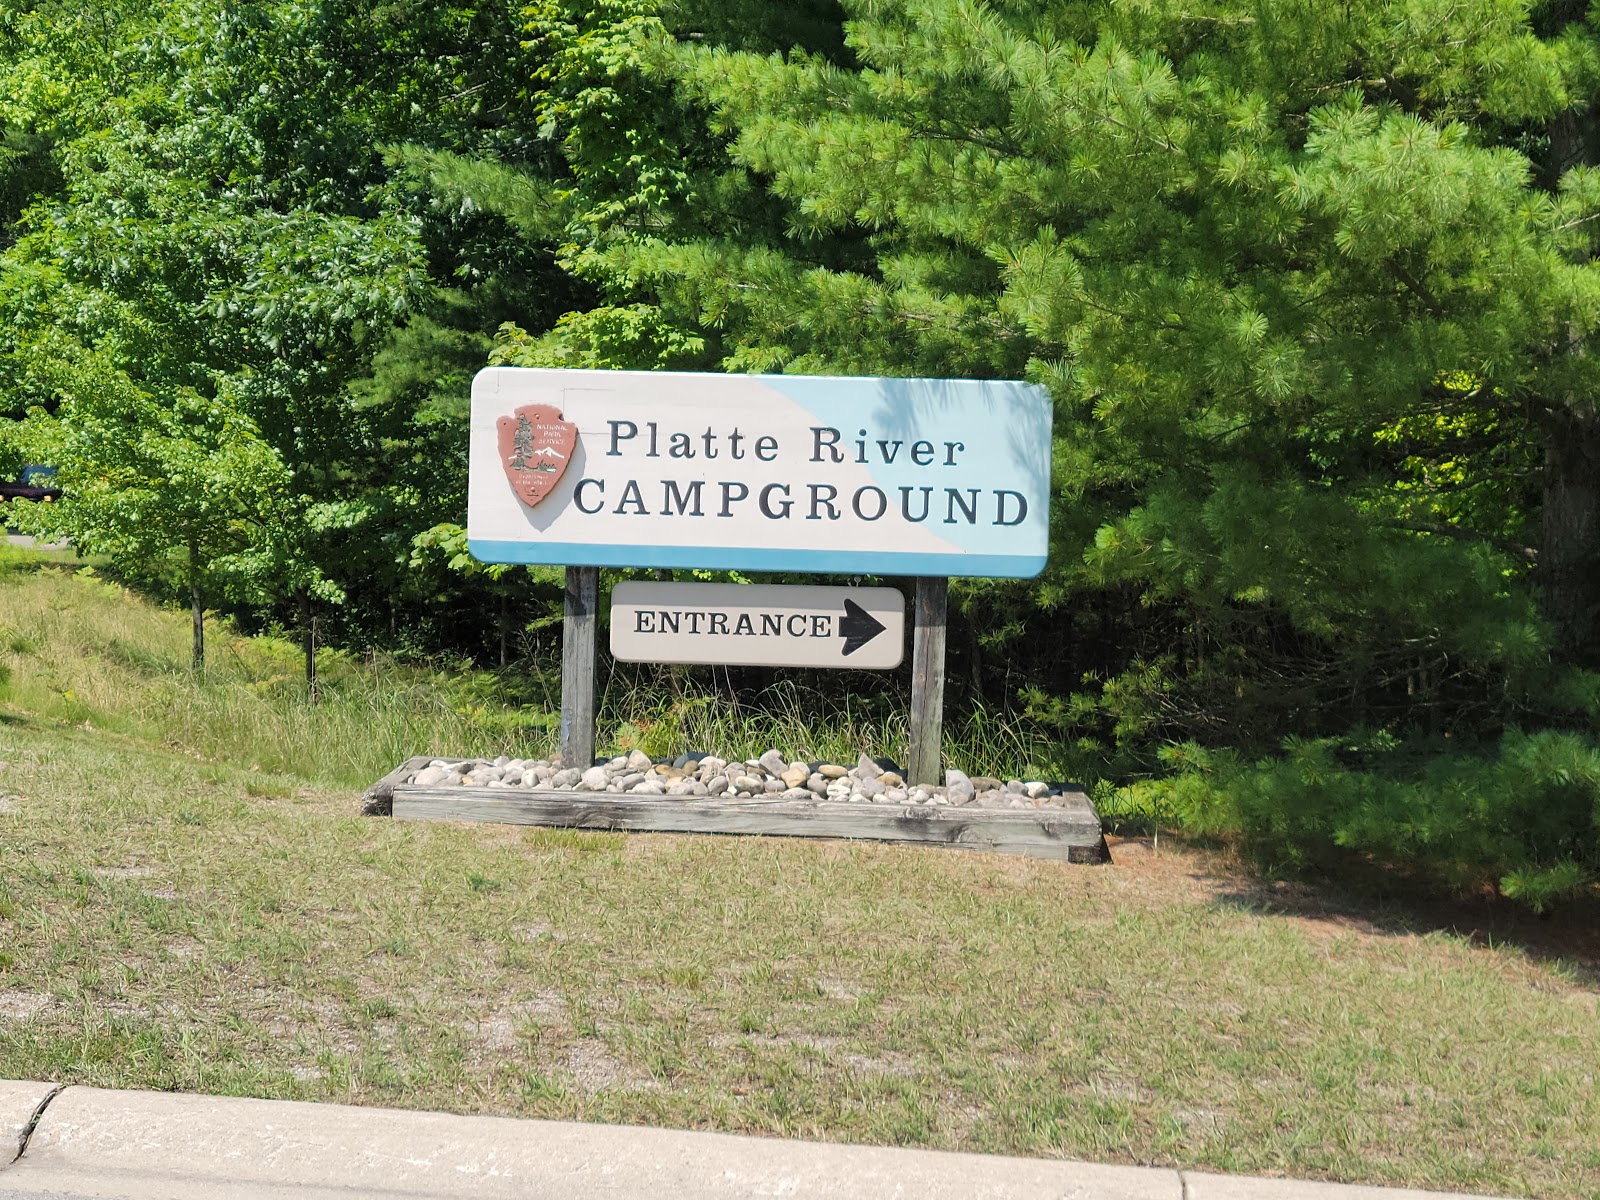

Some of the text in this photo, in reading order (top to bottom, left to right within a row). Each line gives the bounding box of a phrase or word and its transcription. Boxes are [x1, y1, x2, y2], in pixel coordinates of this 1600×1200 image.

[536, 424, 568, 432] NATIONAL
[606, 420, 965, 466] Platte River
[573, 478, 1028, 526] CAMPGROUND
[633, 610, 832, 638] ENTRANCE
